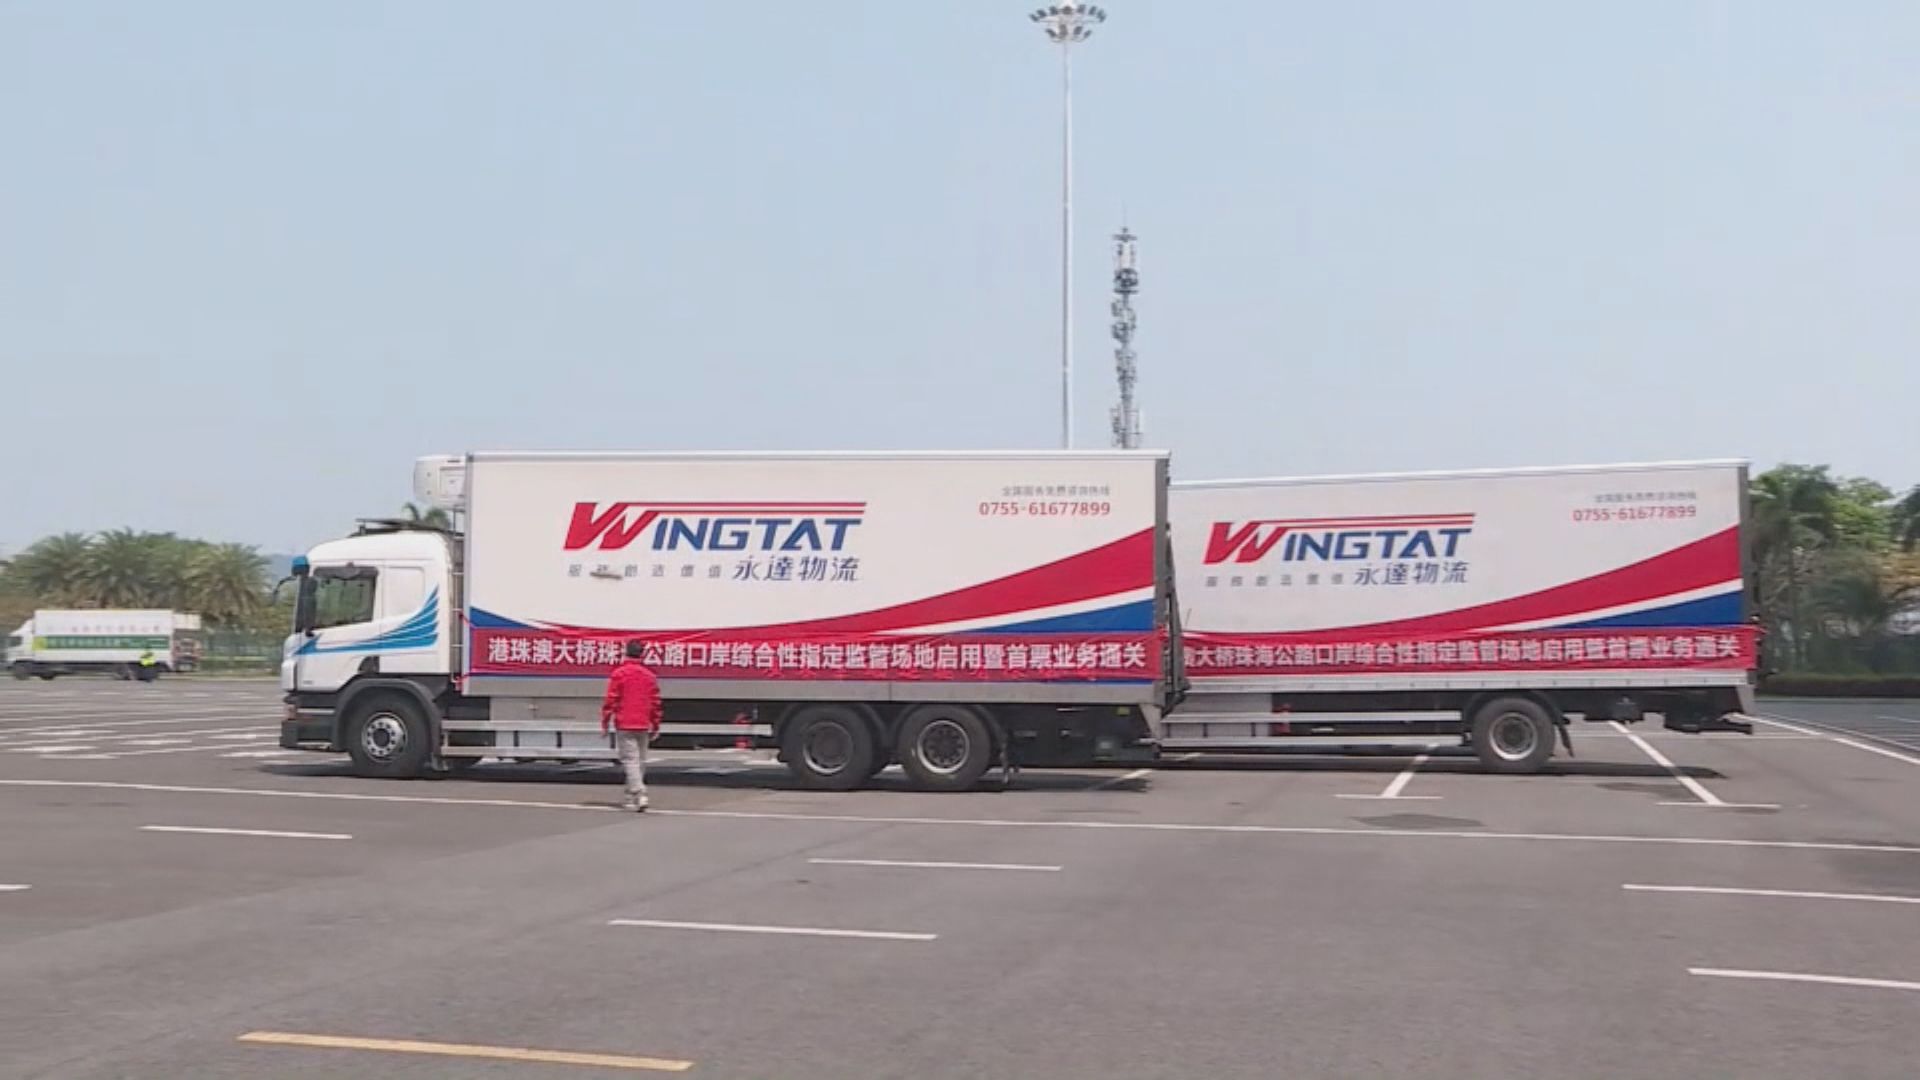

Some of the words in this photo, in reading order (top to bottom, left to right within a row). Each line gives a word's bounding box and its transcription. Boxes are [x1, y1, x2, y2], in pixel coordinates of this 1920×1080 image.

[979, 502, 1111, 516] 0755-61677899
[1572, 505, 1697, 522] 0755-61677899
[562, 501, 866, 551] WINGTAT
[1203, 513, 1475, 564] WINGTAT
[732, 554, 861, 582] 永達物流
[1353, 561, 1470, 586] 永達物流
